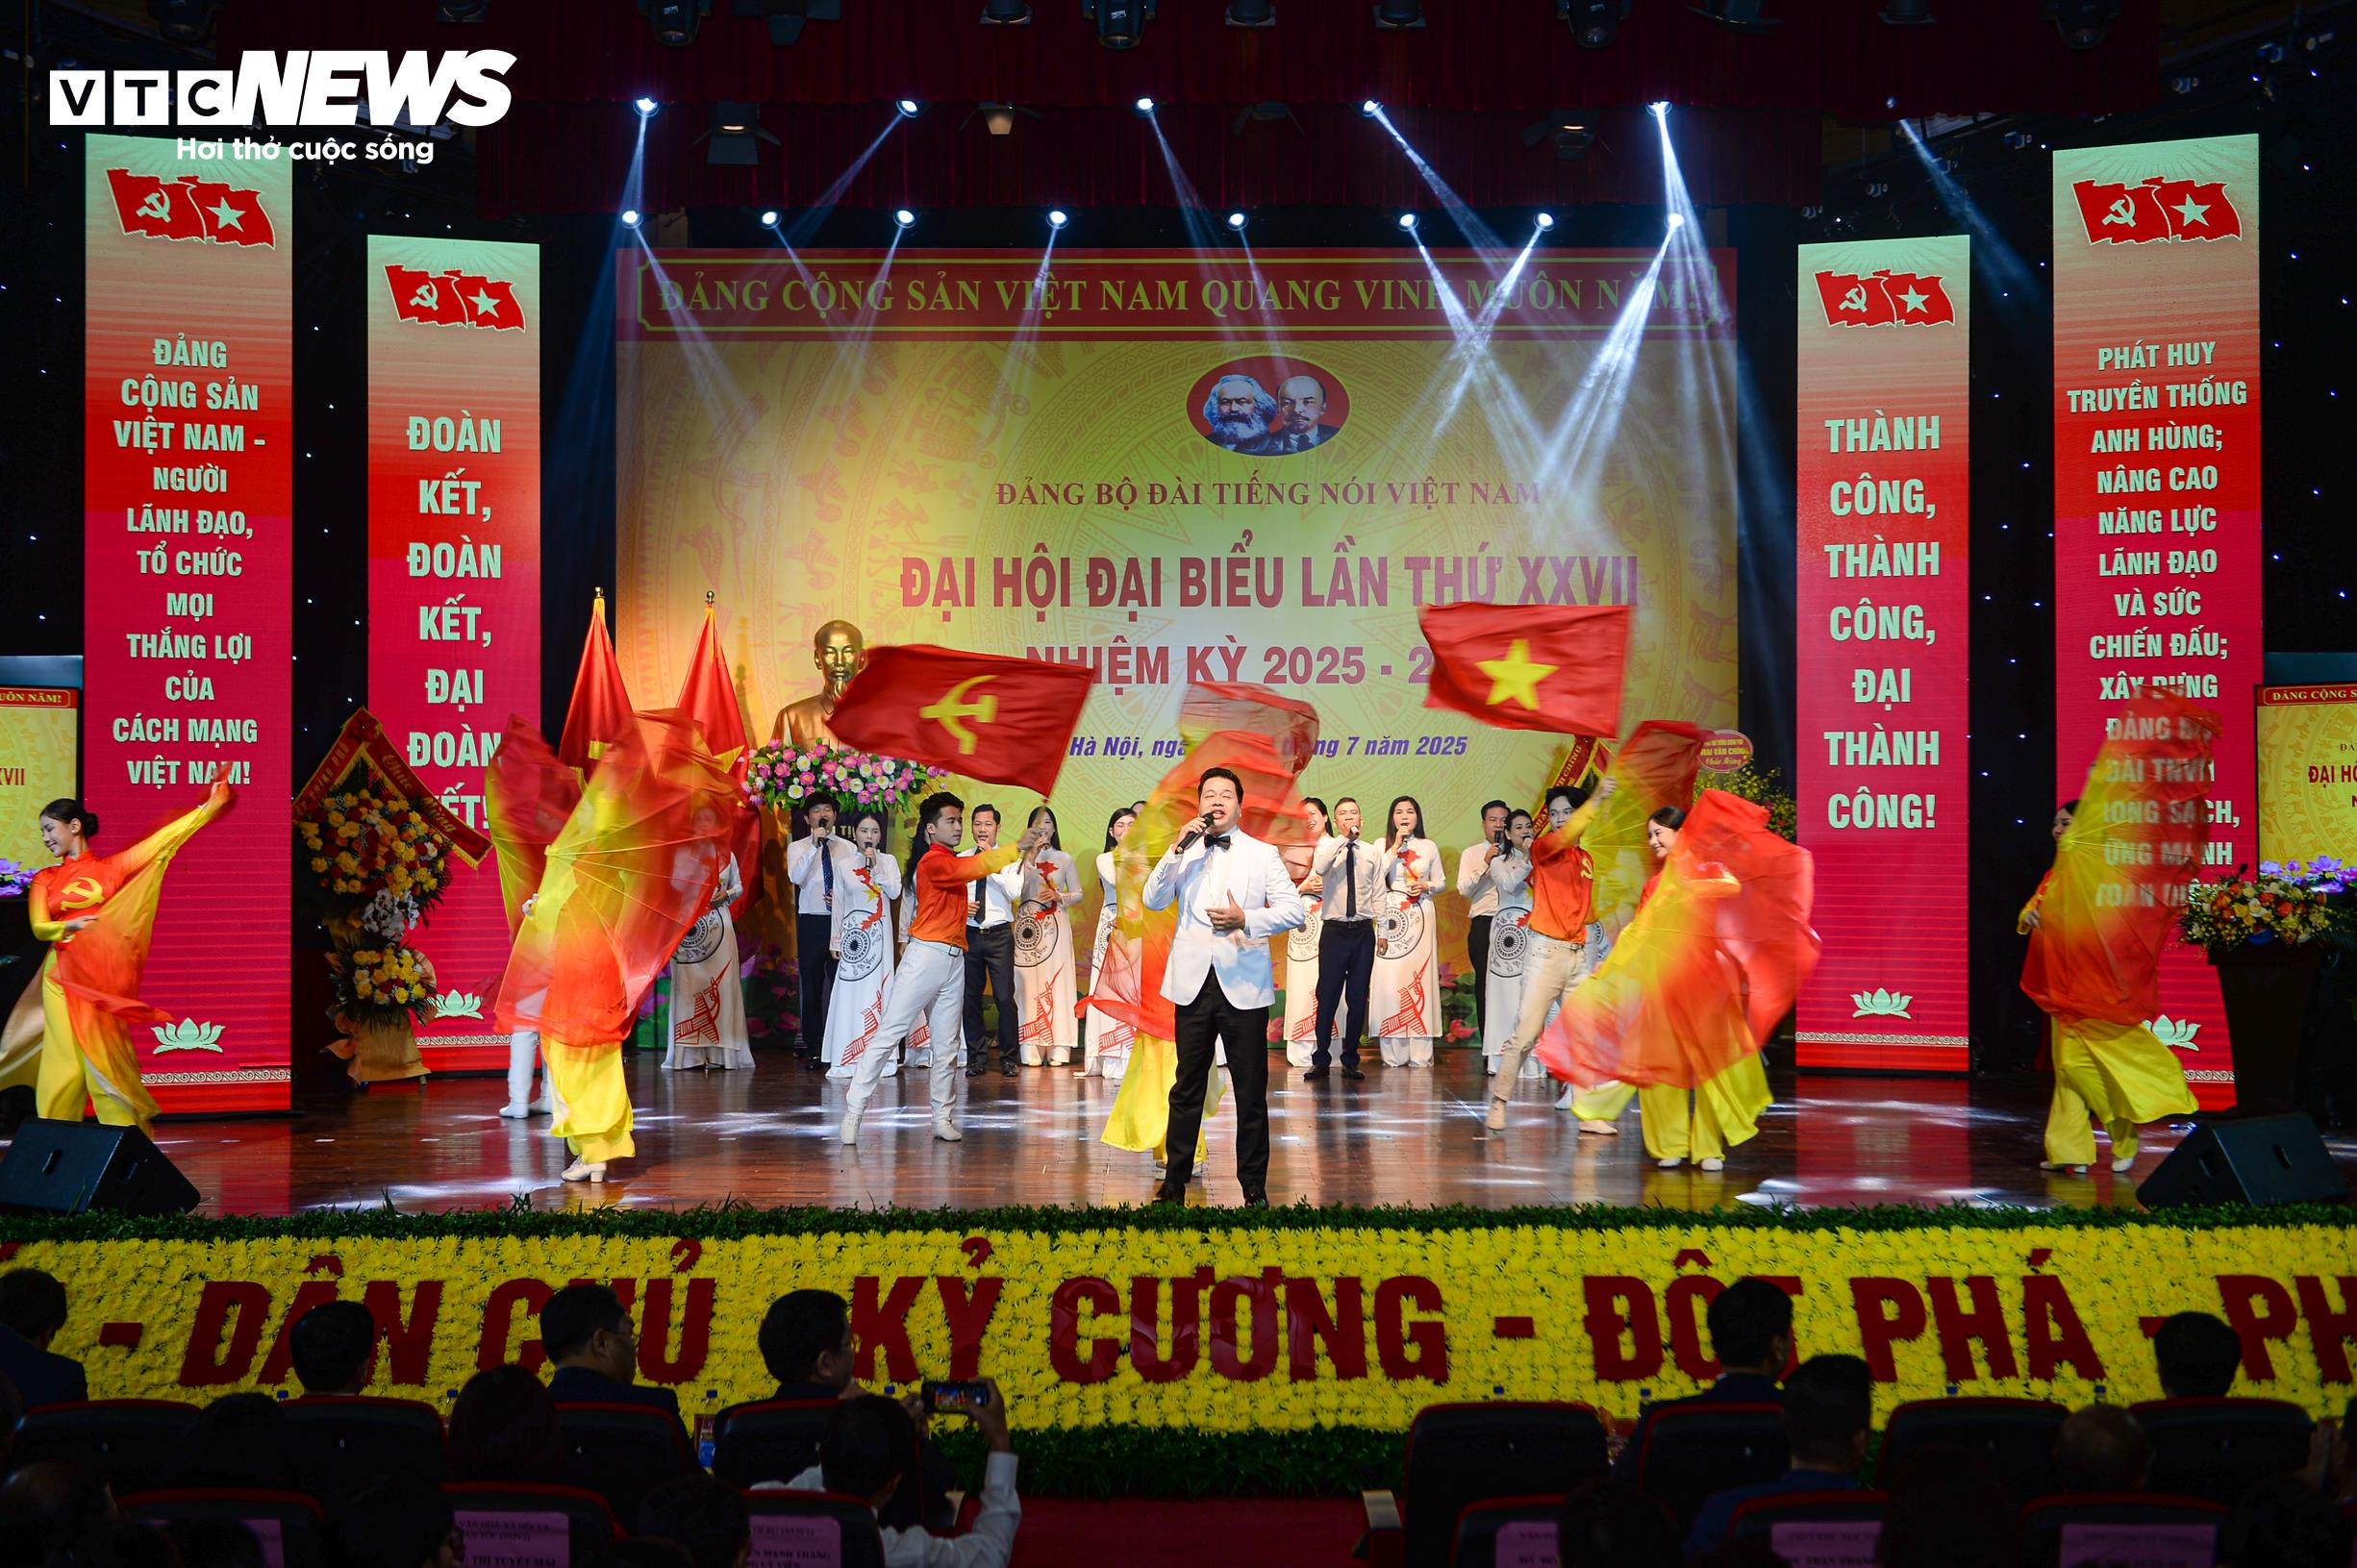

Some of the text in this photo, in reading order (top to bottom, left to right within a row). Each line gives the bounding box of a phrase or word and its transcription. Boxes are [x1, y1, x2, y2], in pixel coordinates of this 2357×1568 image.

[659, 271, 769, 311] ĐẢNG
[782, 271, 895, 319] CỘNG
[907, 271, 983, 311] SẢN
[993, 270, 1088, 319] VIỆT
[1100, 280, 1189, 311] NAM
[1201, 279, 1341, 317] QUANG
[153, 333, 227, 368] ĐẢNG
[2097, 339, 2217, 371] PHÁT HUY
[121, 373, 260, 412] CỘNG SẢN
[2068, 374, 2247, 412] TRUYỀN THỐNG
[114, 415, 267, 455] VIỆT NAM -
[406, 411, 501, 453] ĐOÀN
[1824, 409, 1941, 453] THÀNH
[2092, 424, 2222, 453] ANH HÙNG;
[153, 462, 228, 493] NGƯỜI
[419, 468, 491, 521] KẾT,
[995, 469, 1541, 511] ĐẢNG BỘ ĐÀI TIẾNG NÓI VIỆT NAM
[1830, 473, 1936, 518] CÔNG,
[2097, 465, 2218, 493] NÂNG CAO
[127, 504, 253, 538] LÃNH ĐẠO,
[2099, 507, 2217, 535] NĂNG LỰC
[138, 540, 243, 576] TỔ CHỨC
[407, 536, 501, 579] ĐOÀN
[900, 529, 1638, 622] ĐẠI HỘI ĐẠI BIỂU LẦN THỨ XXVII
[1824, 535, 1940, 578] THÀNH
[2099, 549, 2219, 578] LÃNH ĐẠO
[167, 593, 213, 621] MỌI
[420, 594, 491, 647] KẾT,
[1830, 597, 1936, 645] CÔNG,
[2115, 589, 2201, 616] VÀ SỨC
[127, 627, 253, 661] THẮNG LỢI
[1187, 635, 1247, 684] KỲ
[1263, 646, 1366, 685] 2025
[2091, 628, 2228, 660] CHIẾN ĐẤU;
[28, 692, 63, 703] NĂM!
[164, 669, 215, 701] CỦA
[425, 669, 484, 711] ĐẠI
[1852, 668, 1911, 710] ĐẠI
[2272, 689, 2308, 702] ĐẢNG
[2311, 688, 2347, 701] CỘNG
[113, 712, 258, 749] CÁCH MẠNG
[407, 724, 501, 767] ĐOÀN
[1069, 736, 1096, 757] Hà
[1103, 736, 1143, 760] Nội,
[1346, 736, 1361, 756] 7
[1364, 736, 1410, 757] năm
[1416, 736, 1468, 757] 2025
[1824, 722, 1940, 766] THÀNH
[127, 755, 250, 788] VIỆT NAM!
[2308, 764, 2336, 788] ĐẠI
[1828, 785, 1935, 829] CÔNG!
[852, 1236, 1004, 1382] KỶ
[1050, 1265, 1450, 1384] CƯƠNG
[1849, 1248, 2107, 1382] PHÁ
